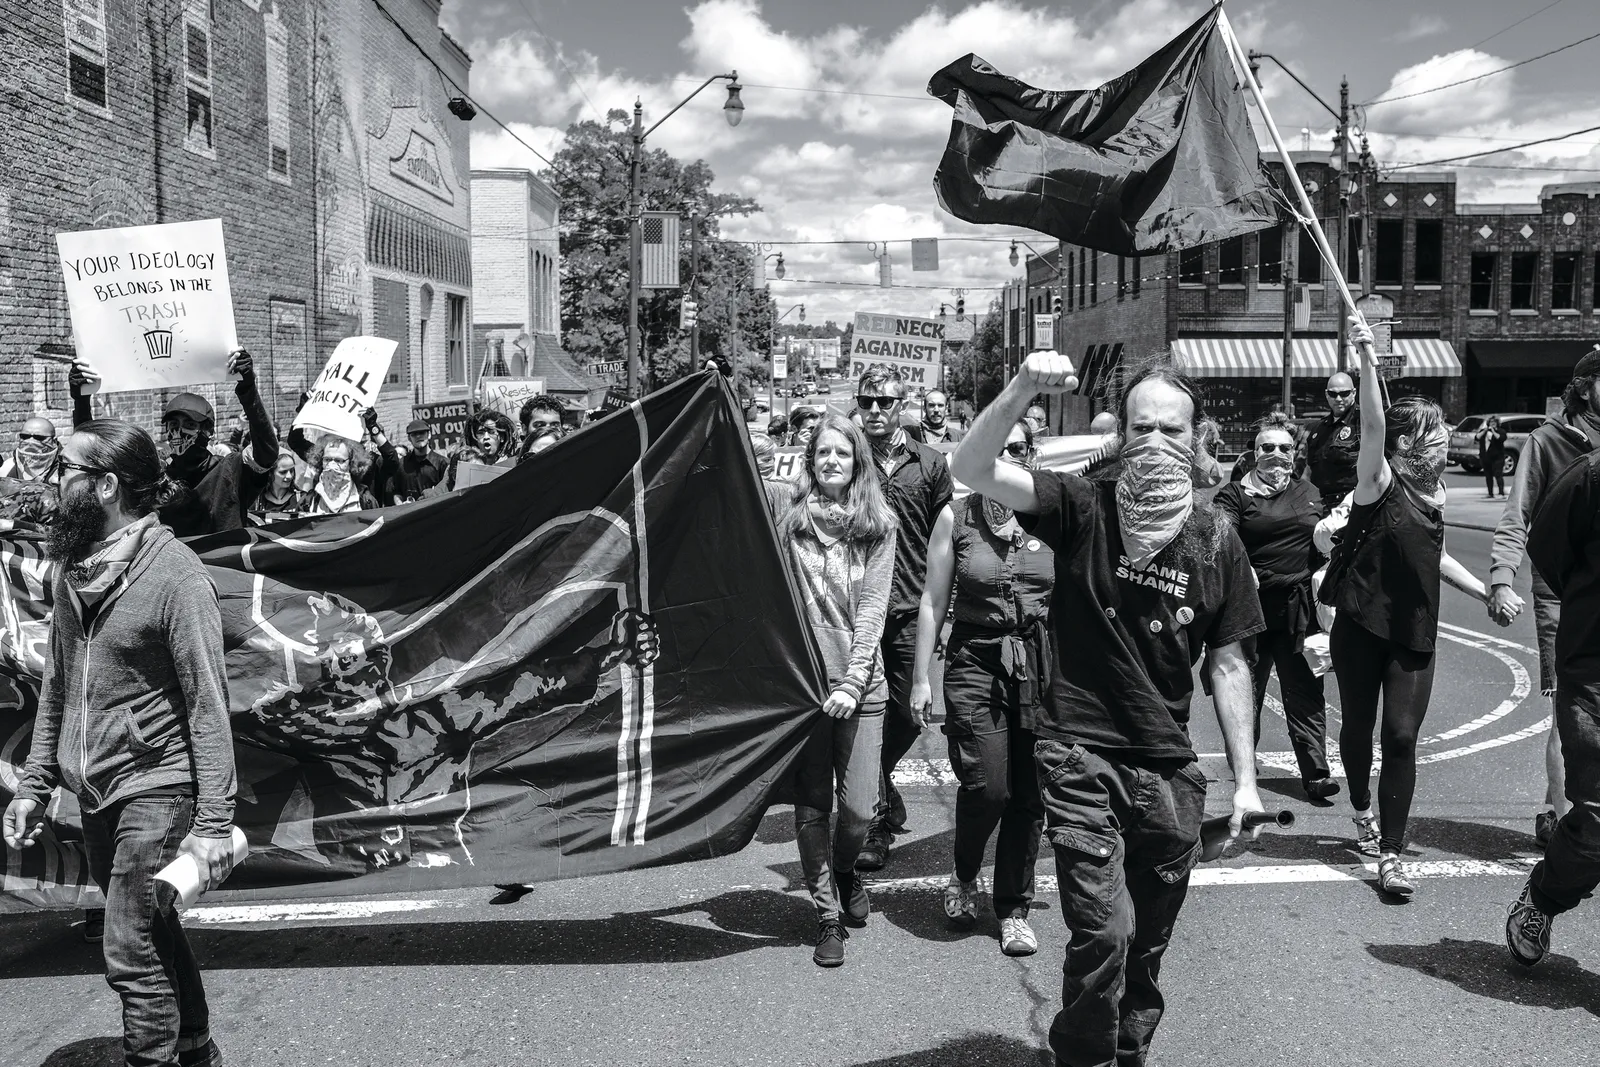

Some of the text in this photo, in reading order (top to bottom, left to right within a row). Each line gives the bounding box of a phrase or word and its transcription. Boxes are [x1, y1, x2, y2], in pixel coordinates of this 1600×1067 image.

[65, 250, 214, 281] YOUR IDEOLOGY
[93, 277, 213, 302] BELONGS IN THE
[119, 301, 187, 323] TRASH
[856, 314, 945, 340] REDNECK
[854, 338, 937, 362] AGAINST
[1378, 356, 1400, 366] Worth
[597, 362, 625, 373] TRADE
[852, 361, 925, 383] RSM
[312, 390, 364, 413] RACIST
[413, 404, 467, 421] NO HATE
[607, 396, 631, 408] WHIT
[428, 421, 467, 435] N OU
[1119, 554, 1190, 586] SAME
[1115, 566, 1187, 599] SHAME
